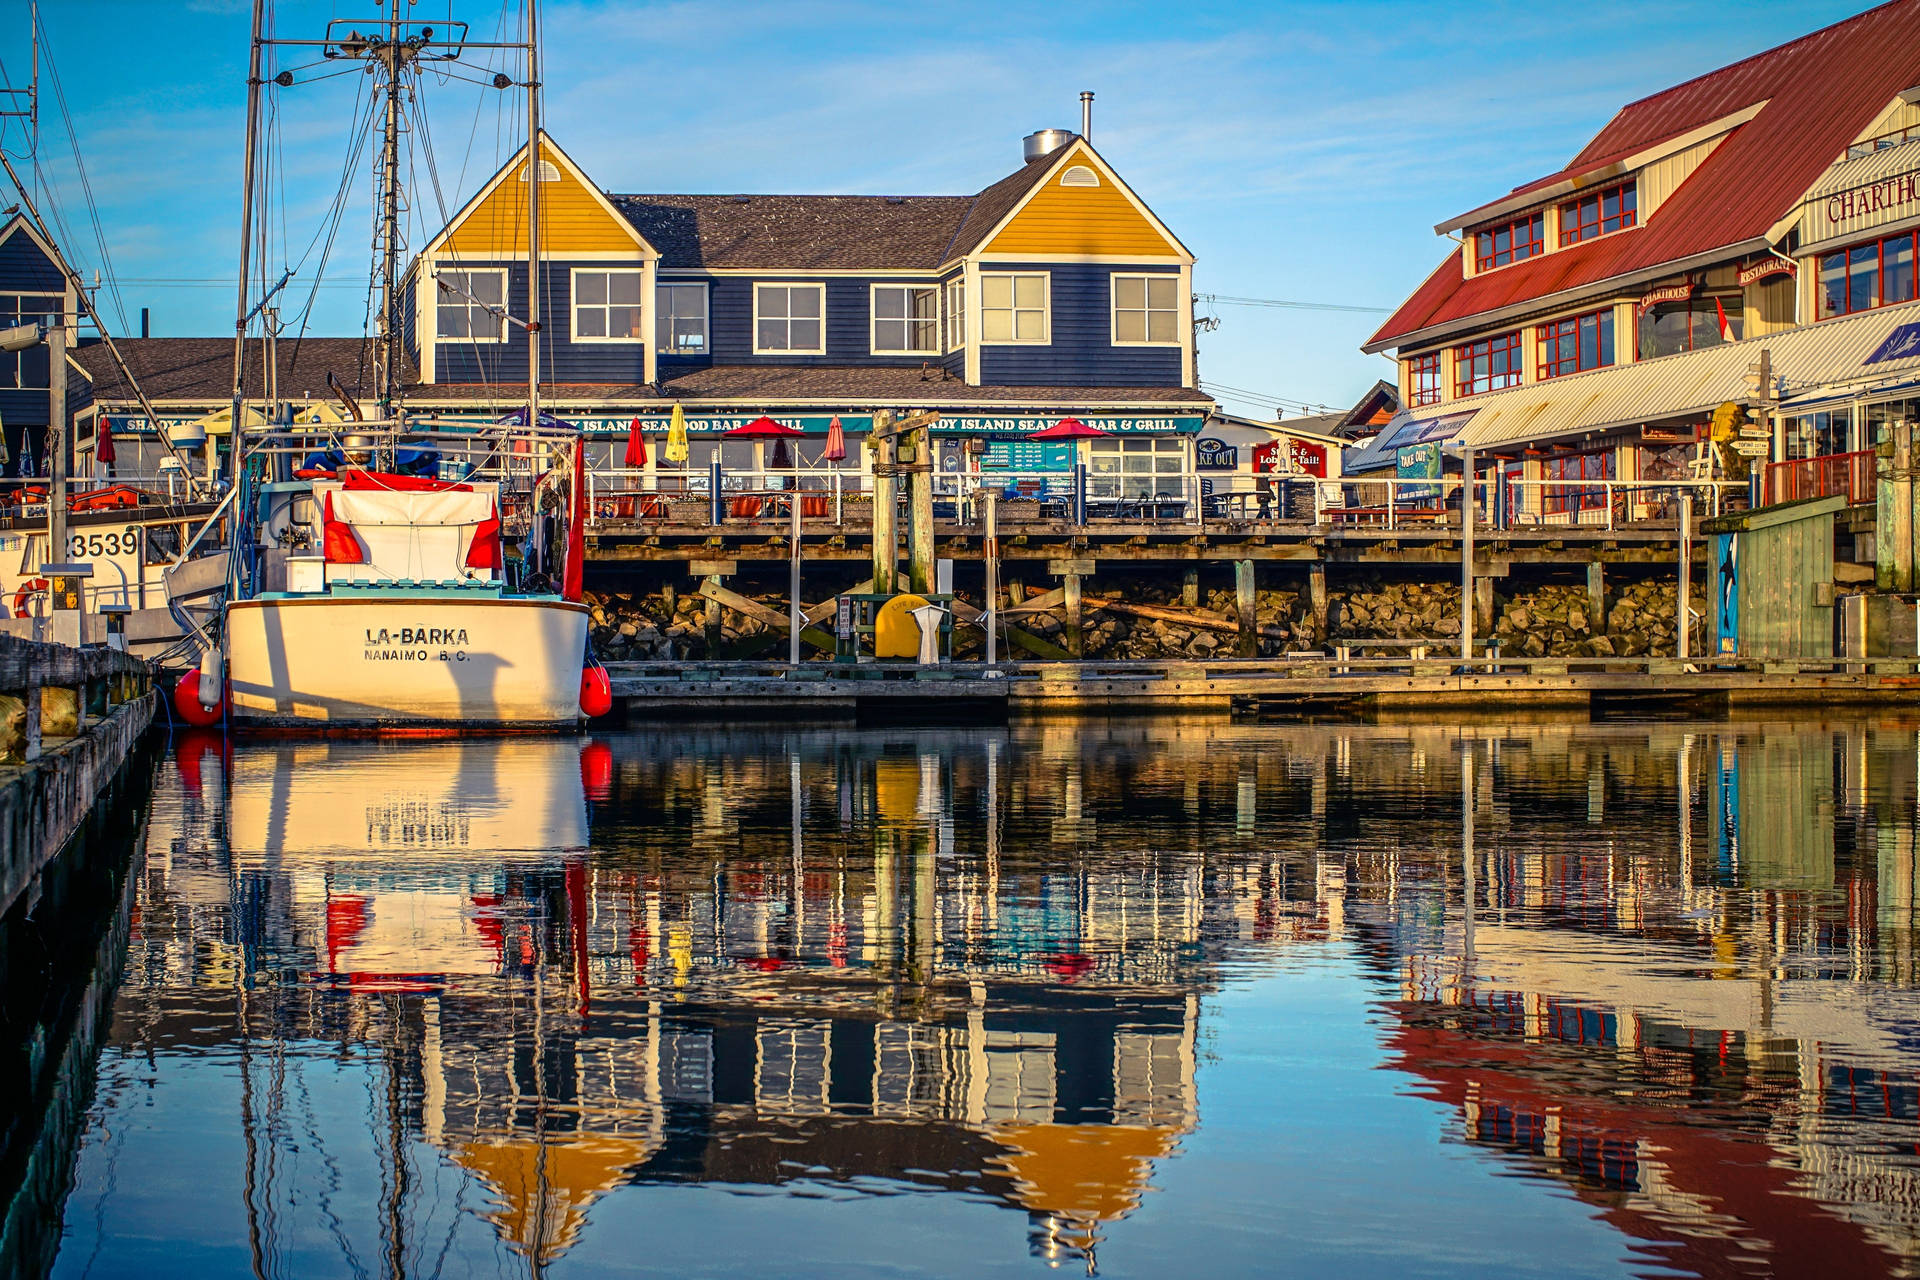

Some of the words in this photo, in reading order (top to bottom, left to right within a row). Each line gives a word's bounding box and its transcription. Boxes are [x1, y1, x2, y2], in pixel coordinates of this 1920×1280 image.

[1740, 257, 1790, 283] RESTAURANT
[1641, 285, 1689, 307] CHARTHOUSE
[583, 420, 632, 431] ISLAN
[641, 420, 708, 431] SEAOD
[712, 420, 742, 431] BAR
[927, 419, 958, 429] ADY
[960, 420, 1015, 430] ISLAND
[1088, 420, 1117, 430] BAR
[1120, 420, 1132, 430] &
[1135, 420, 1177, 430] GRILL
[1216, 449, 1235, 465] OUT
[1270, 447, 1298, 456] Stk
[1300, 448, 1307, 456] &
[1401, 454, 1414, 467] TAKE
[1415, 450, 1427, 462] OUT
[1260, 456, 1297, 464] Lobr
[1298, 456, 1319, 464] Tail!
[67, 532, 137, 558] 3539
[365, 628, 469, 645] LA-BARKA
[365, 650, 427, 661] NANAIMO
